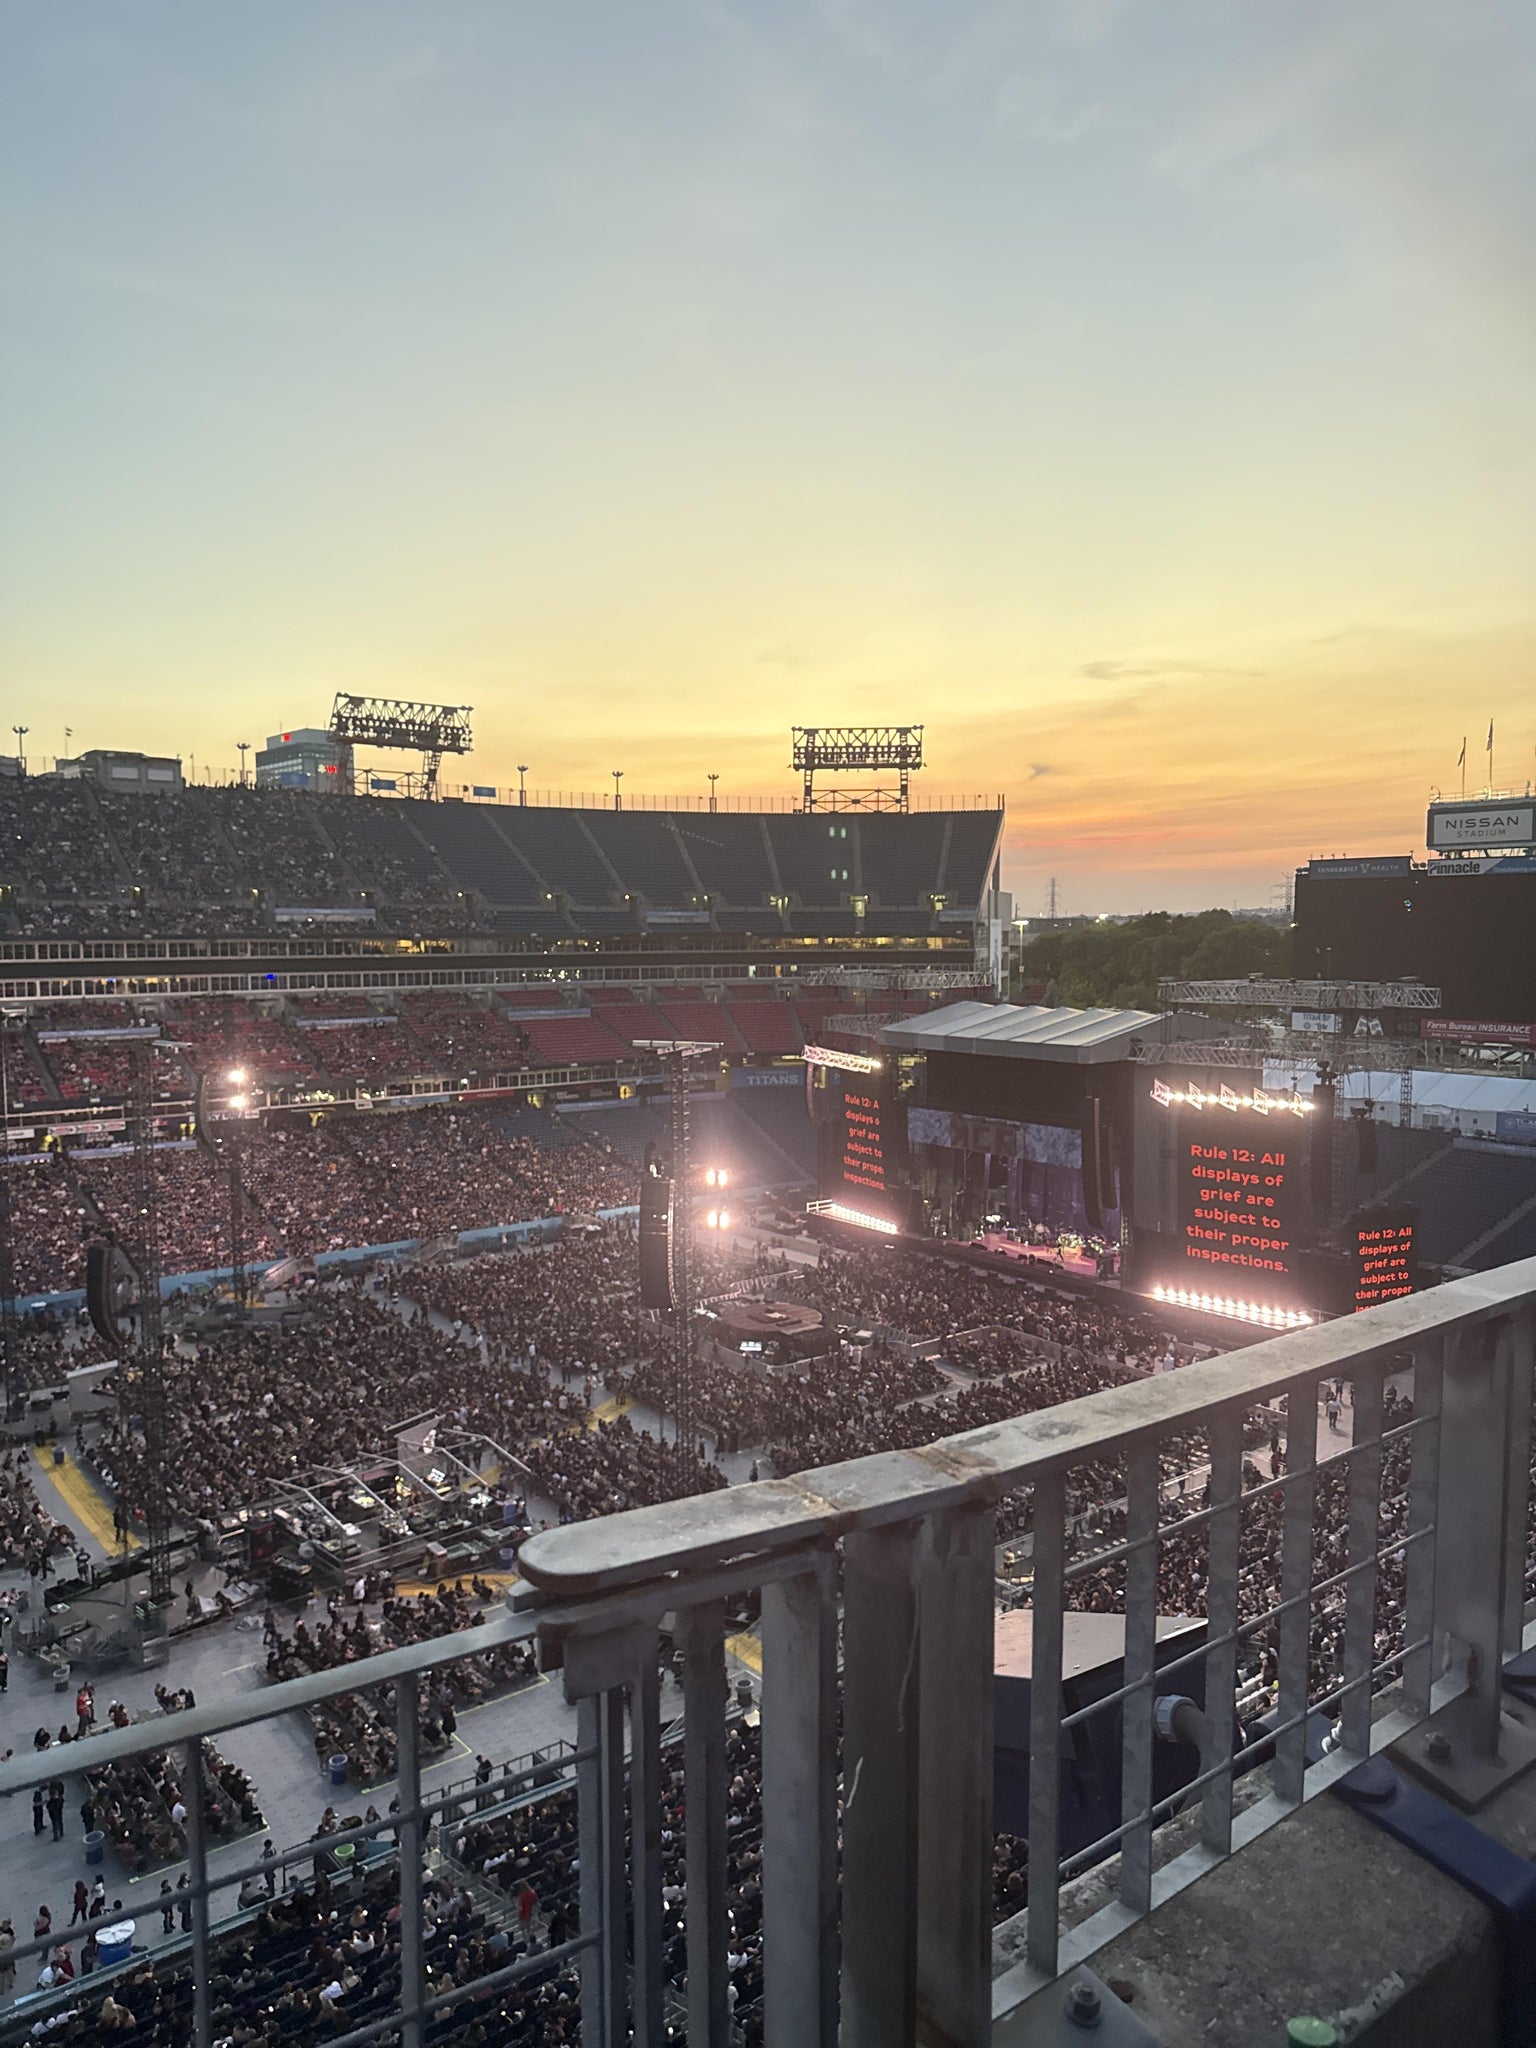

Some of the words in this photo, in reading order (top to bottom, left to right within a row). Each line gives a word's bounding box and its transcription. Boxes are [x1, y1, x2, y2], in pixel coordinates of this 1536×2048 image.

[1445, 816, 1519, 829] NISSAN
[1456, 829, 1506, 838] STADIUM
[1371, 864, 1399, 872] HEALTH
[1429, 861, 1480, 875] Pinnacle
[1427, 1021, 1446, 1029] Farm
[1449, 1022, 1476, 1031] Bureau
[1478, 1024, 1531, 1034] INSURANCE
[747, 1074, 798, 1085] TITANS
[844, 1094, 860, 1106] Rule
[845, 1109, 873, 1126] displays
[848, 1127, 867, 1138] grief
[867, 1132, 880, 1141] are
[847, 1142, 873, 1157] subject
[874, 1148, 883, 1158] to
[1190, 1144, 1227, 1160] Rule
[1232, 1148, 1256, 1162] 12:
[1260, 1152, 1285, 1166] All
[844, 1156, 861, 1168] their
[844, 1172, 887, 1191] inspections.
[1191, 1166, 1260, 1186] displays
[1264, 1174, 1284, 1187] of
[1199, 1188, 1241, 1203] grief
[1246, 1193, 1275, 1207] are
[1194, 1207, 1256, 1227] subject
[1261, 1215, 1281, 1229] to
[1186, 1225, 1227, 1242] their
[1231, 1231, 1289, 1251] proper
[1358, 1230, 1380, 1241] Rule
[1382, 1229, 1396, 1239] 12:
[1398, 1227, 1412, 1237] All
[1359, 1244, 1398, 1256] displays
[1400, 1242, 1411, 1252] of
[1186, 1245, 1289, 1273] inspections.
[1363, 1258, 1388, 1271] grief
[1389, 1257, 1406, 1267] are
[1360, 1272, 1395, 1285] subject
[1397, 1271, 1409, 1281] to
[1355, 1288, 1380, 1300] their
[1381, 1284, 1413, 1299] proper
